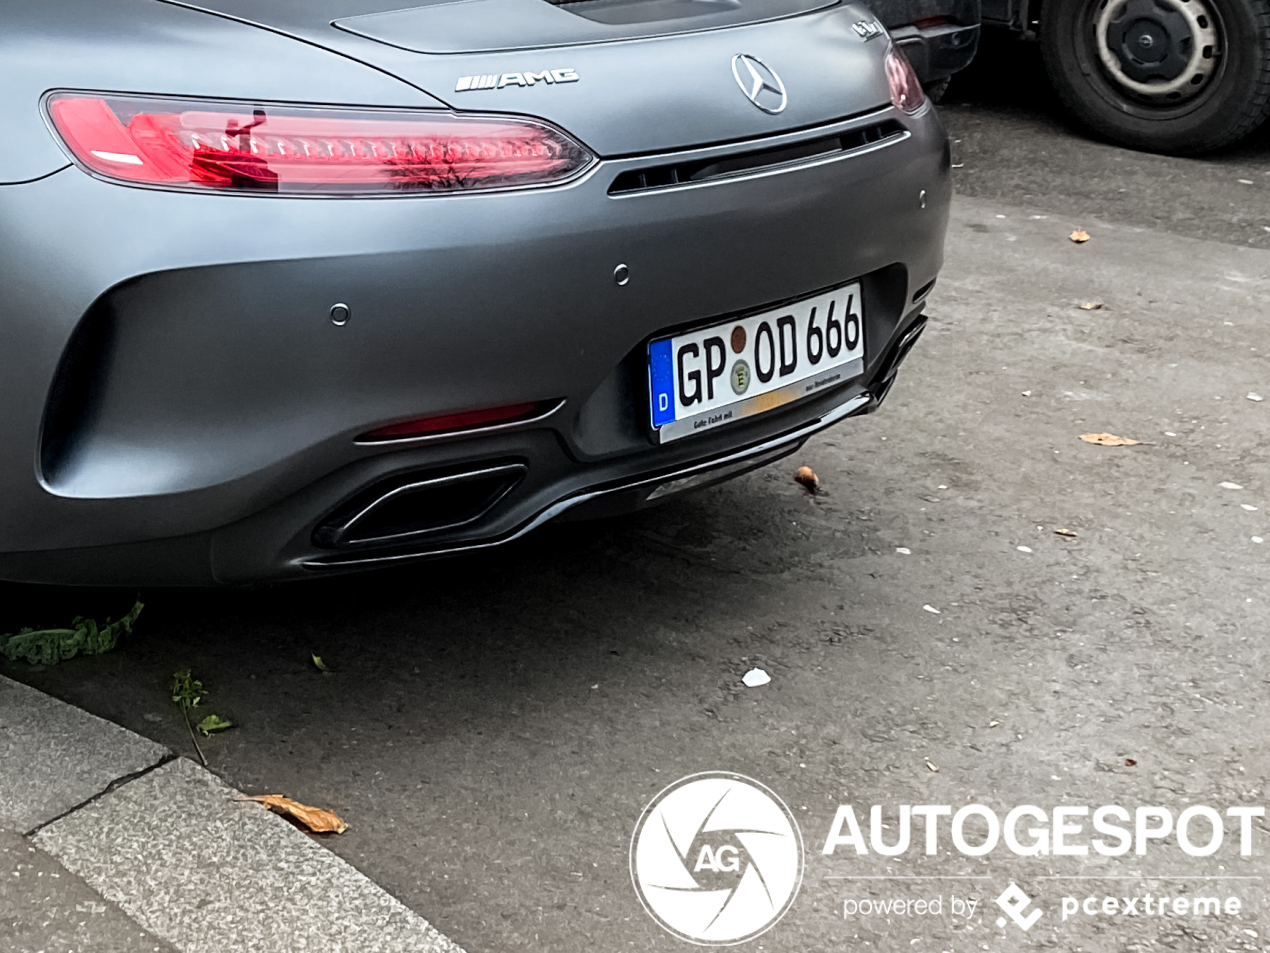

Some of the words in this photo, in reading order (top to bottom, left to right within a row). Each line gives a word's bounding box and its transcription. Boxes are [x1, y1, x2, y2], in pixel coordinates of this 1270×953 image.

[497, 68, 580, 90] AMG
[676, 335, 727, 408] GP
[754, 314, 798, 384] OD
[806, 293, 860, 366] 666
[659, 392, 669, 413] D
